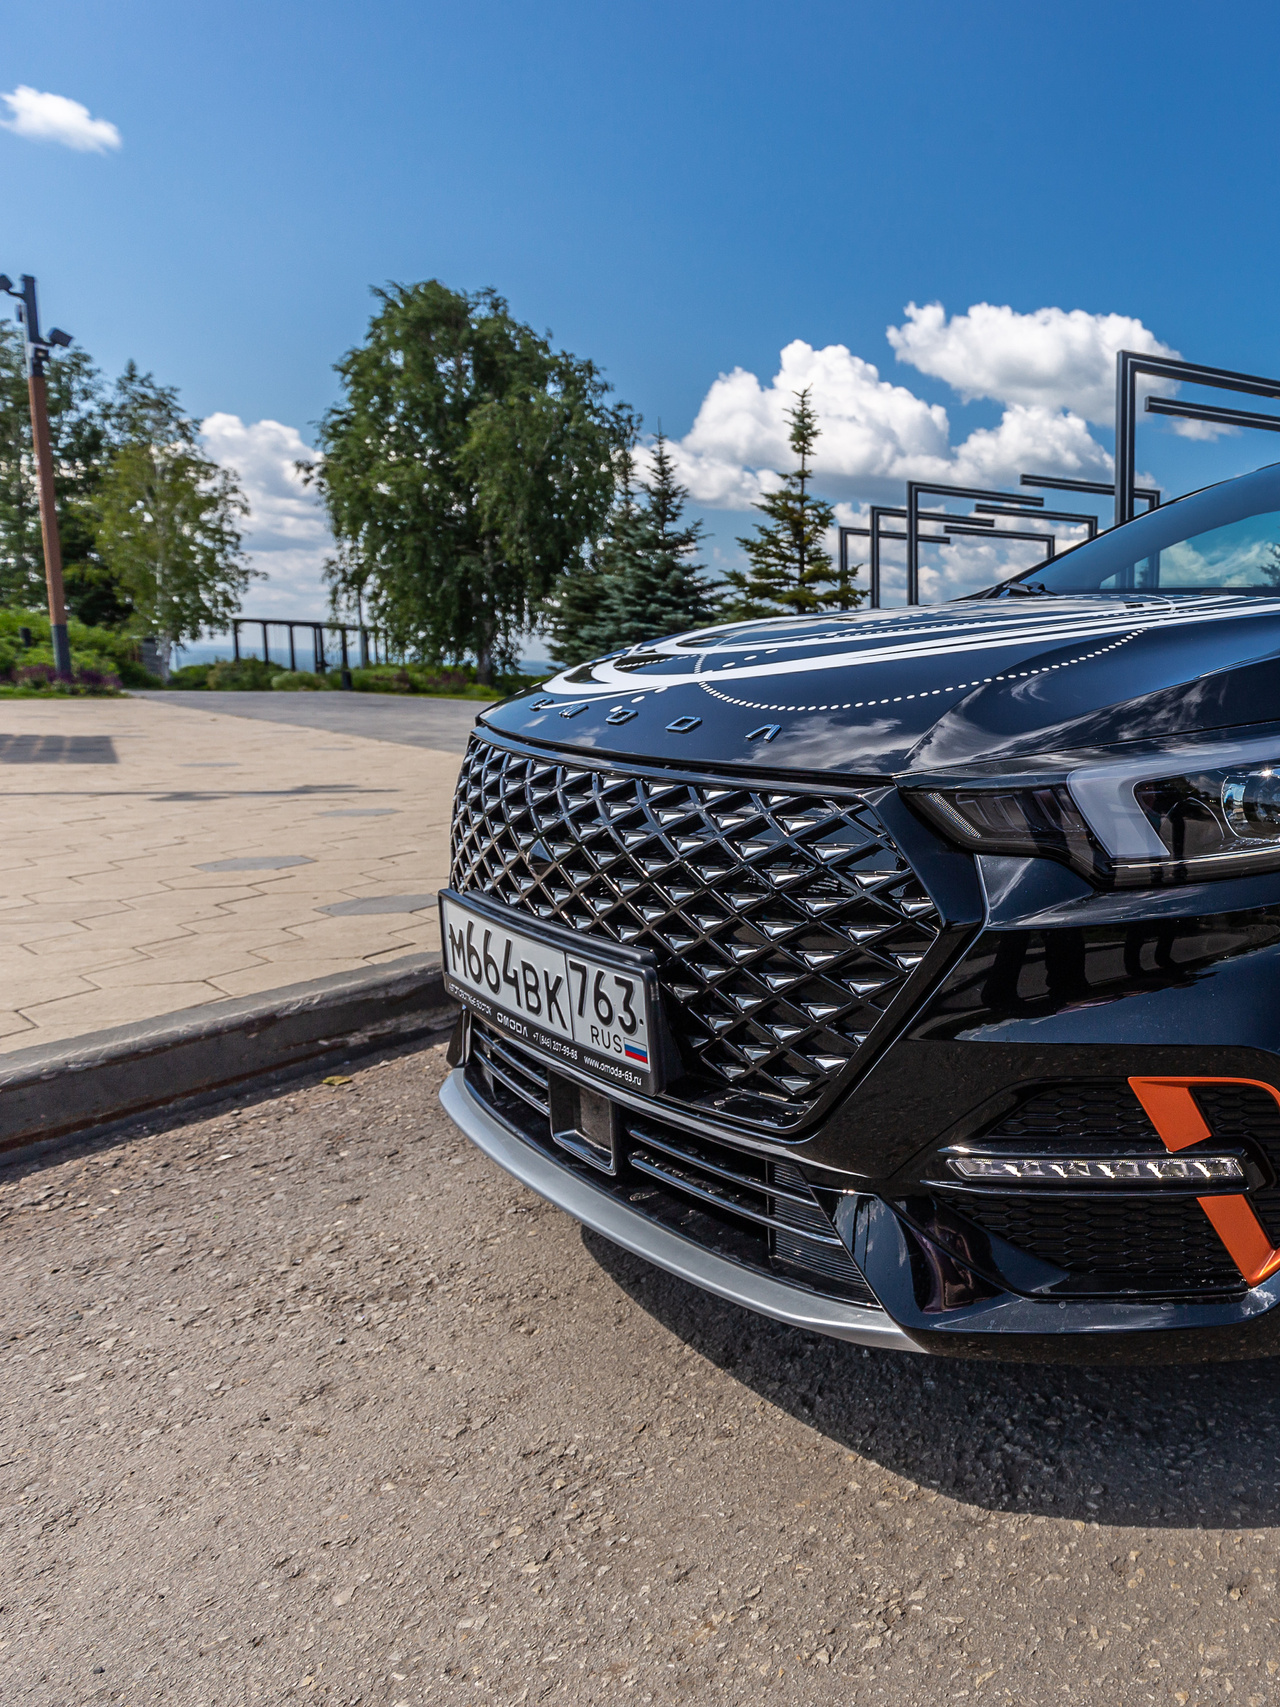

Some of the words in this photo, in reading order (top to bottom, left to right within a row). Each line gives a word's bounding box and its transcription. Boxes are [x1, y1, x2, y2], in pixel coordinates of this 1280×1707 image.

[528, 698, 782, 742] OMODA
[449, 920, 569, 1030] М664ВК
[569, 960, 637, 1035] 763
[496, 1012, 528, 1037] OMODA
[583, 1055, 642, 1086] www.omoda-63.ru
[590, 1025, 623, 1053] RUS
